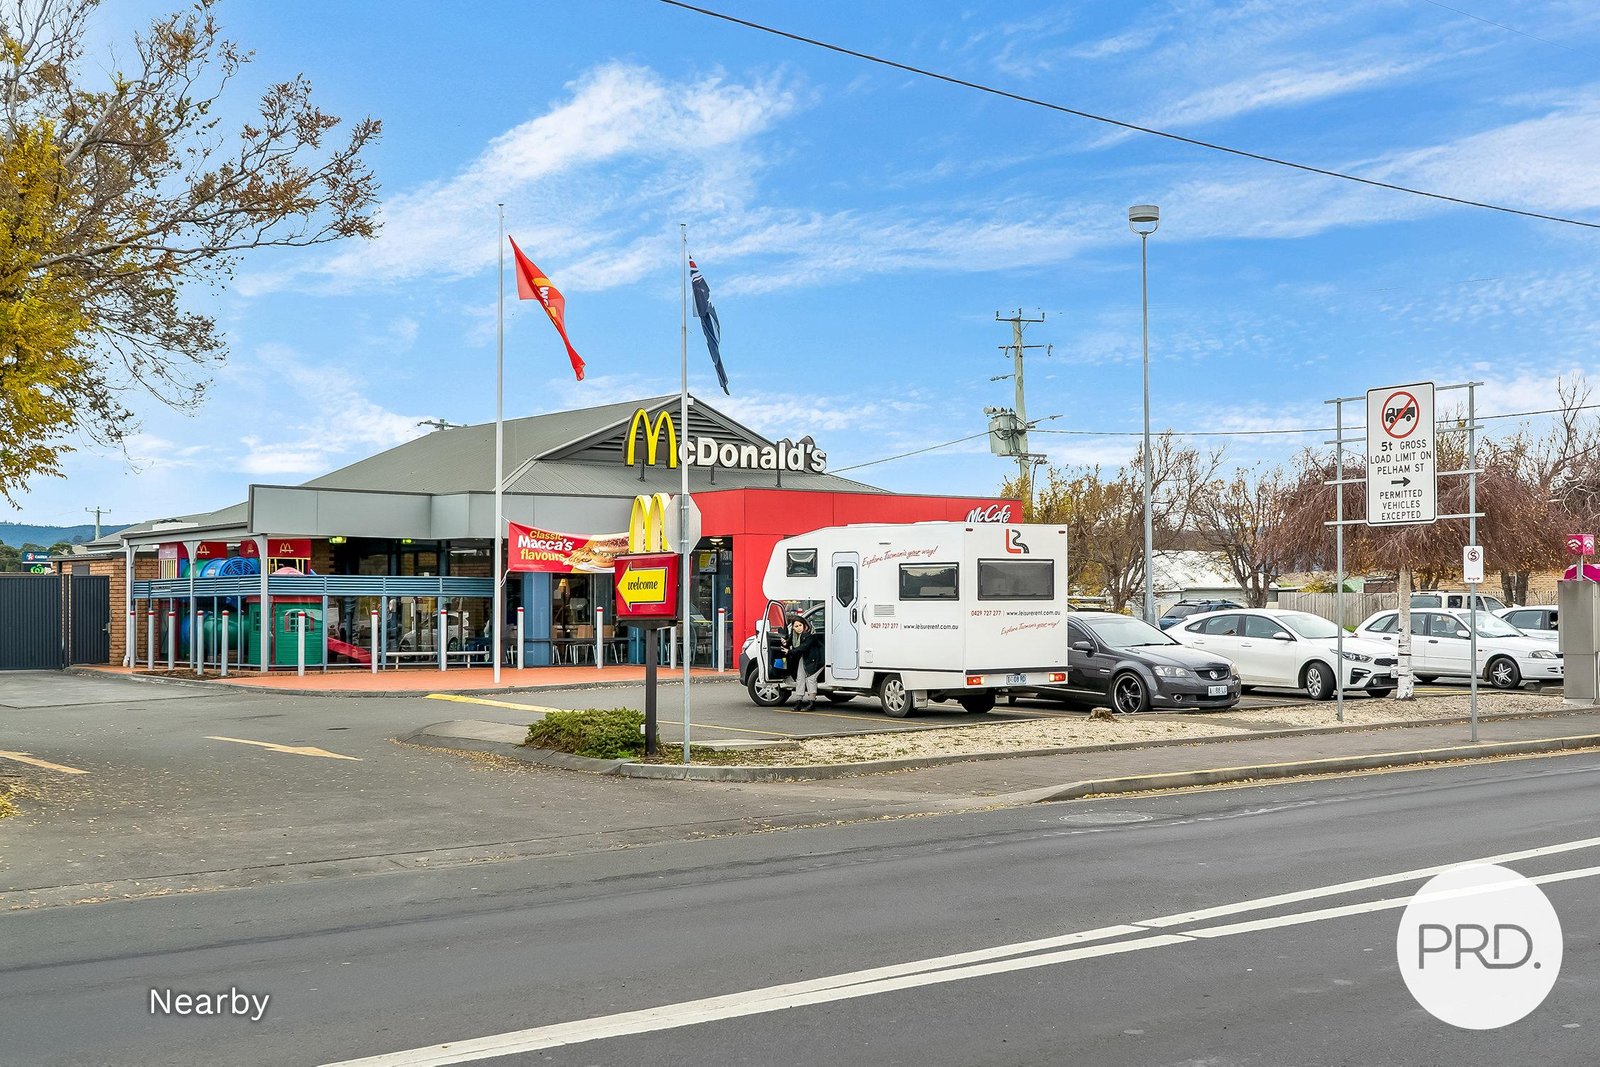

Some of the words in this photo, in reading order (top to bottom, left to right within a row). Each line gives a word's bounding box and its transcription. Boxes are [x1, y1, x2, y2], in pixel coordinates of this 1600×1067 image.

[1381, 441, 1393, 452] 5t
[1400, 439, 1427, 450] GROSS
[1370, 454, 1392, 465] LOAD
[1395, 451, 1416, 462] LIMIT
[1420, 450, 1432, 460] ON
[1377, 464, 1411, 475] PELHAM
[1414, 462, 1424, 473] ST
[1379, 489, 1423, 500] PERMITTED
[1382, 499, 1421, 510] VEHICLES
[1381, 510, 1421, 521] EXCEPTED
[529, 530, 563, 540] Classic
[517, 534, 574, 552] Macca's
[520, 548, 565, 562] flavours
[627, 576, 658, 590] welcome
